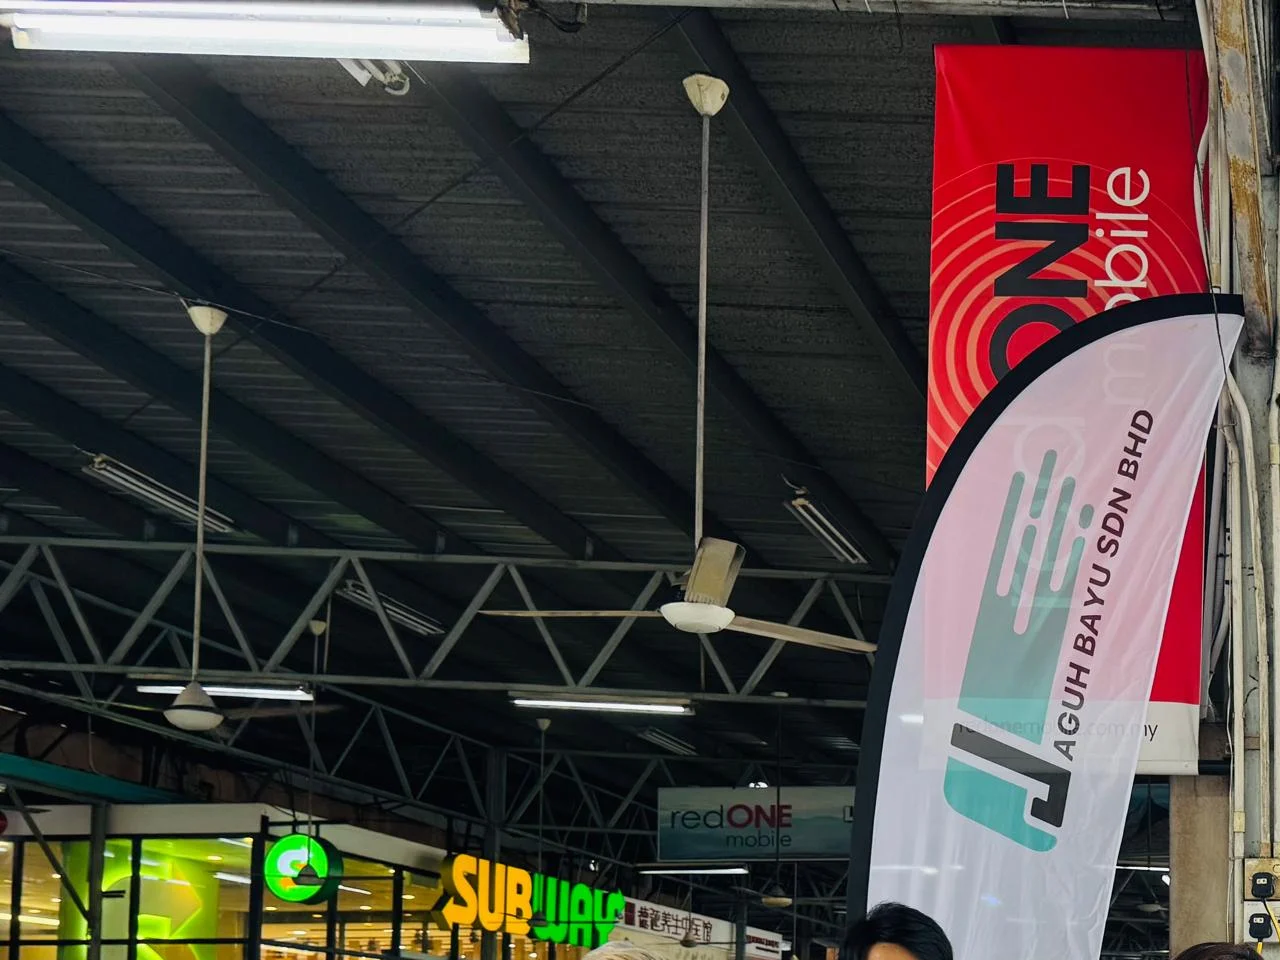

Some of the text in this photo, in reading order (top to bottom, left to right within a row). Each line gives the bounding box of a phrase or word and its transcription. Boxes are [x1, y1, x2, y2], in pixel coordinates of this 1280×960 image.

[1072, 563, 1112, 656] BAYU
[1096, 487, 1133, 558] SDN
[1118, 408, 1154, 481] BHD
[670, 803, 793, 829] redONE
[726, 831, 793, 848] mobile
[441, 852, 626, 948] SUBWAY
